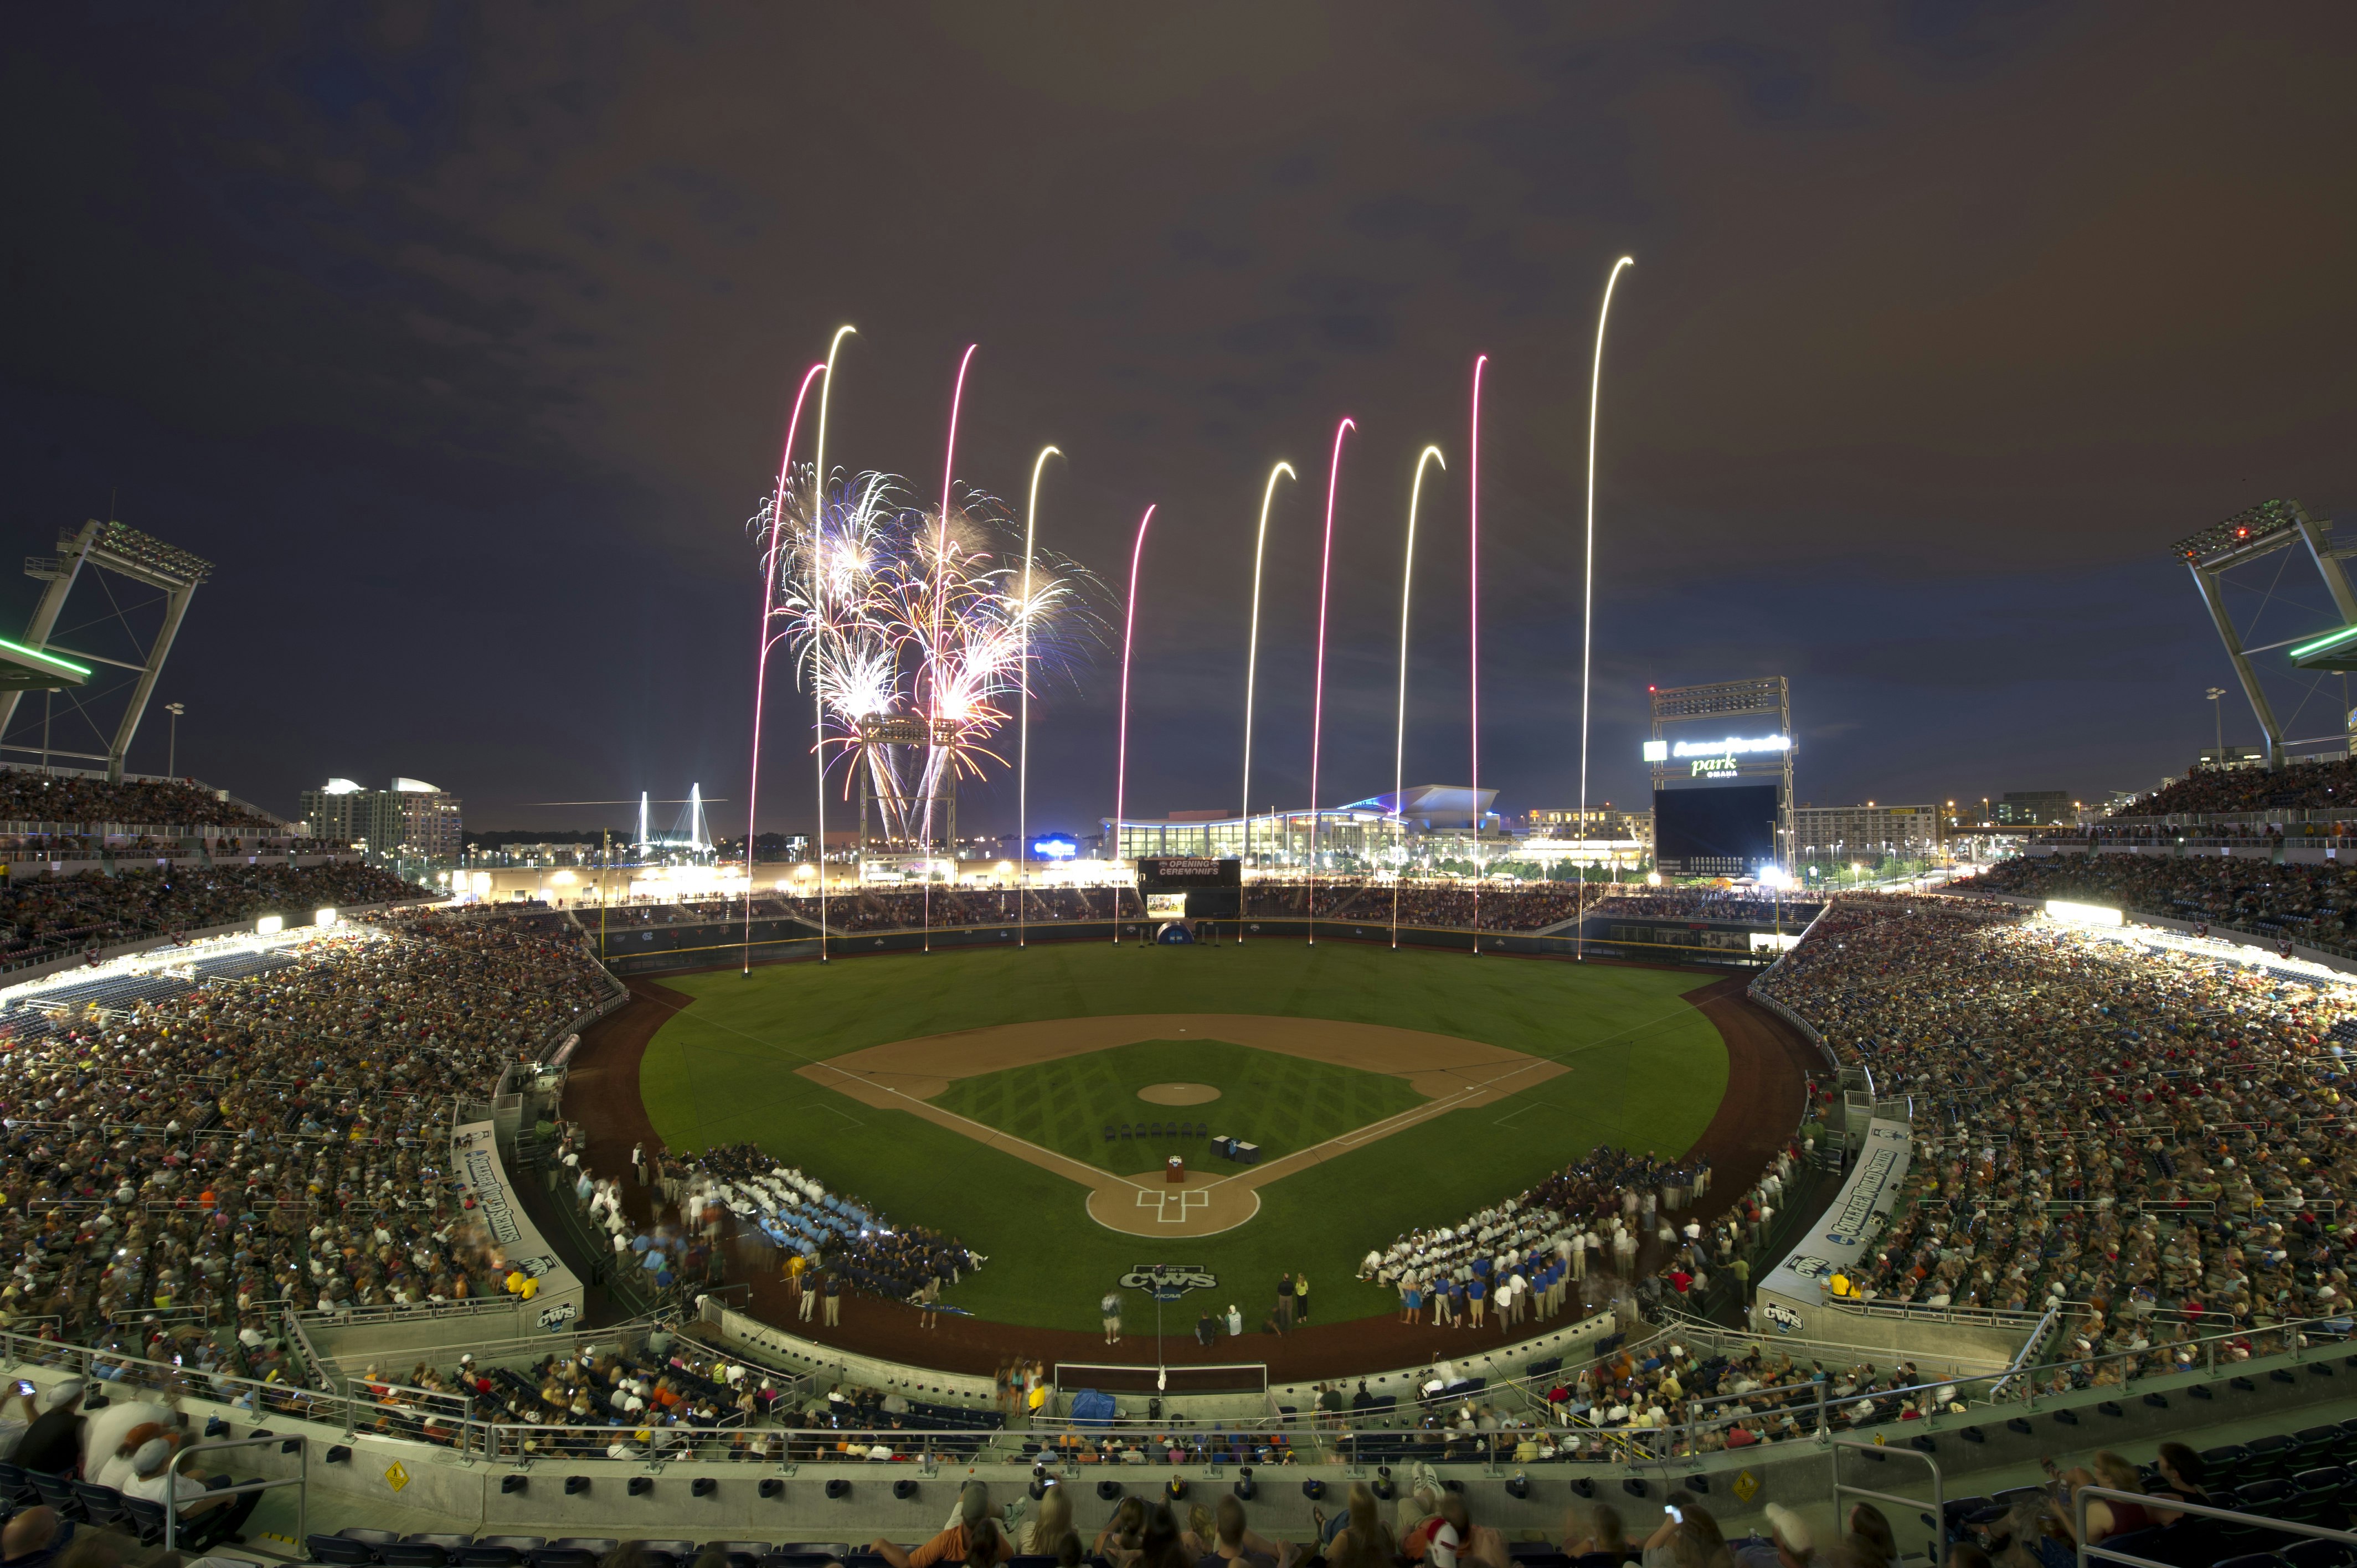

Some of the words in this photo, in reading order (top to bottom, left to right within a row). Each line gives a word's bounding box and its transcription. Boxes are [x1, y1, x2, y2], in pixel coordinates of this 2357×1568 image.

[1691, 752, 1737, 776] park
[1795, 1256, 1830, 1278] CWS
[1119, 1272, 1217, 1288] CWS
[536, 1306, 577, 1329] CWS
[1763, 1307, 1804, 1330] CWS
